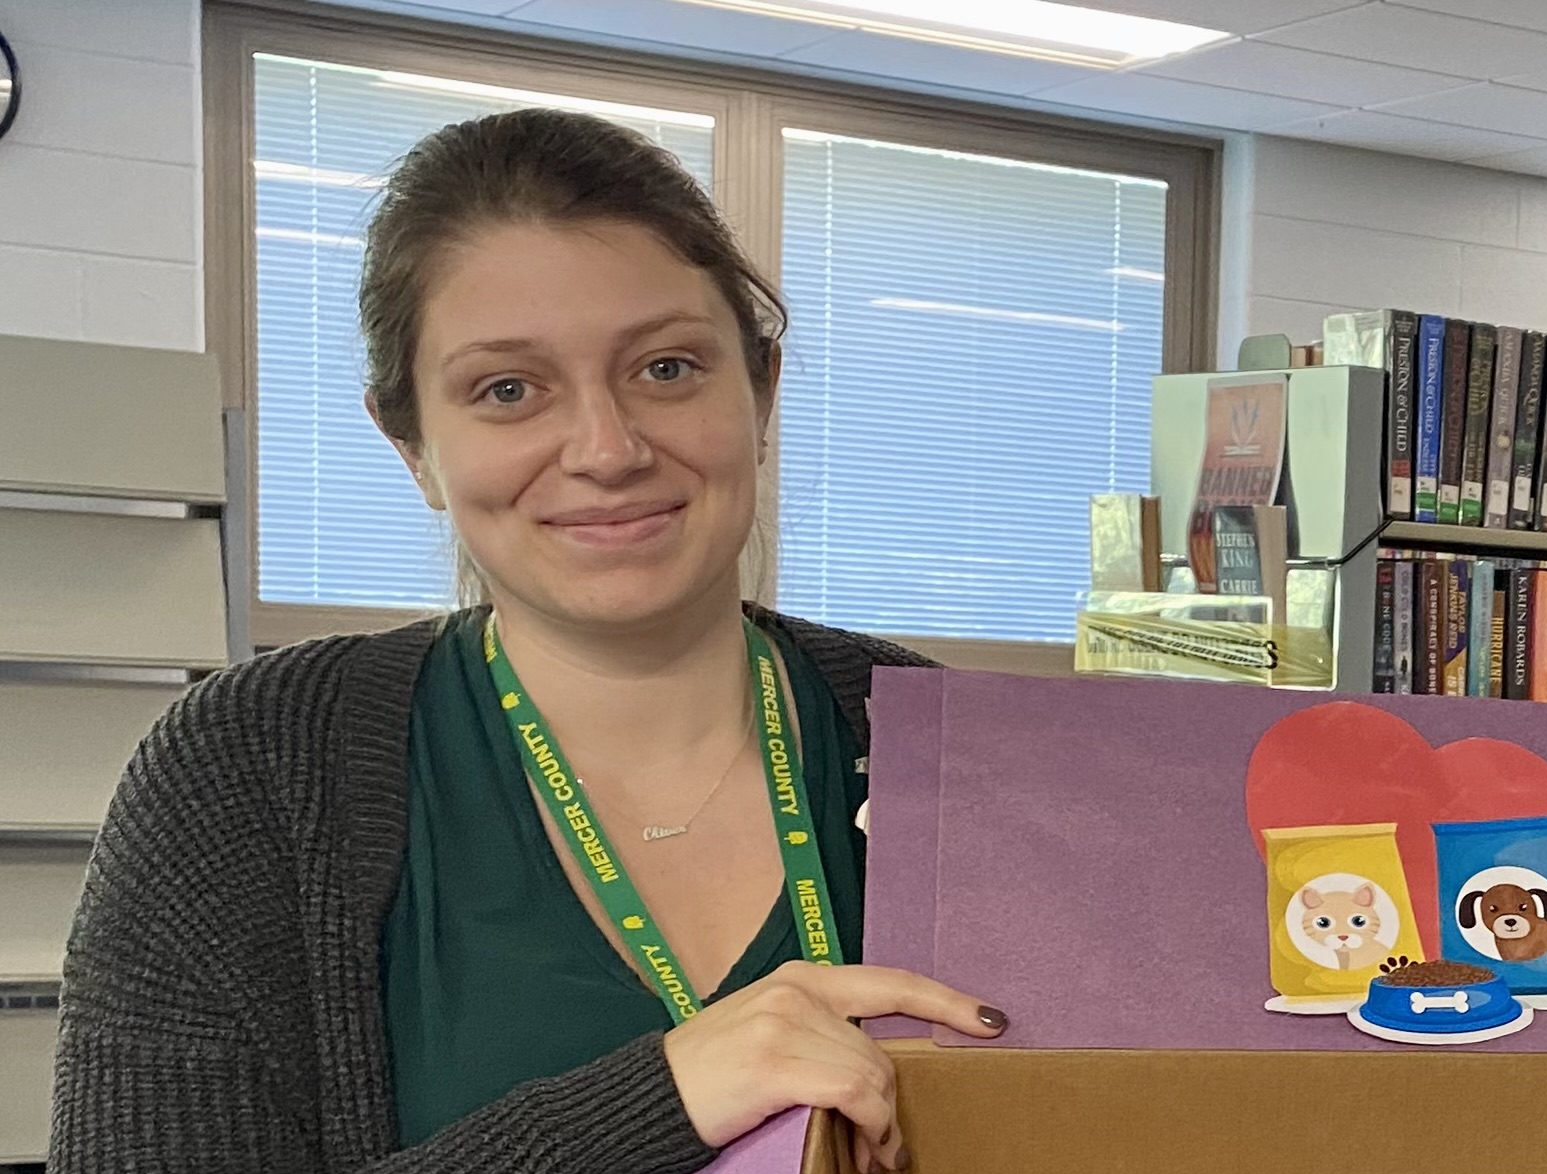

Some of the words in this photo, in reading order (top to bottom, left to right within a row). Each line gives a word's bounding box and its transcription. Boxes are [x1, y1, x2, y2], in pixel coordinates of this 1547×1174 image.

[1397, 337, 1411, 391] PRESTON
[1426, 337, 1440, 385] PRESTON
[1395, 404, 1409, 452] CHILD
[1423, 396, 1437, 434] CHILD
[1428, 589, 1438, 650] CONSPIRACY
[1448, 573, 1459, 620] JENKINS
[1457, 591, 1467, 634] TAYLOR
[1516, 576, 1527, 622] KAREN
[1428, 652, 1437, 665] OF
[1448, 621, 1458, 649] REID
[1488, 617, 1505, 683] HURRICANE
[1515, 625, 1526, 686] ROBARDS
[757, 655, 783, 735] MERCER
[518, 721, 574, 802] COUNTY
[768, 738, 801, 817] COUNTY
[562, 800, 620, 884] MERCER
[795, 879, 830, 957] MERCER
[640, 944, 698, 1020] COUNTY
